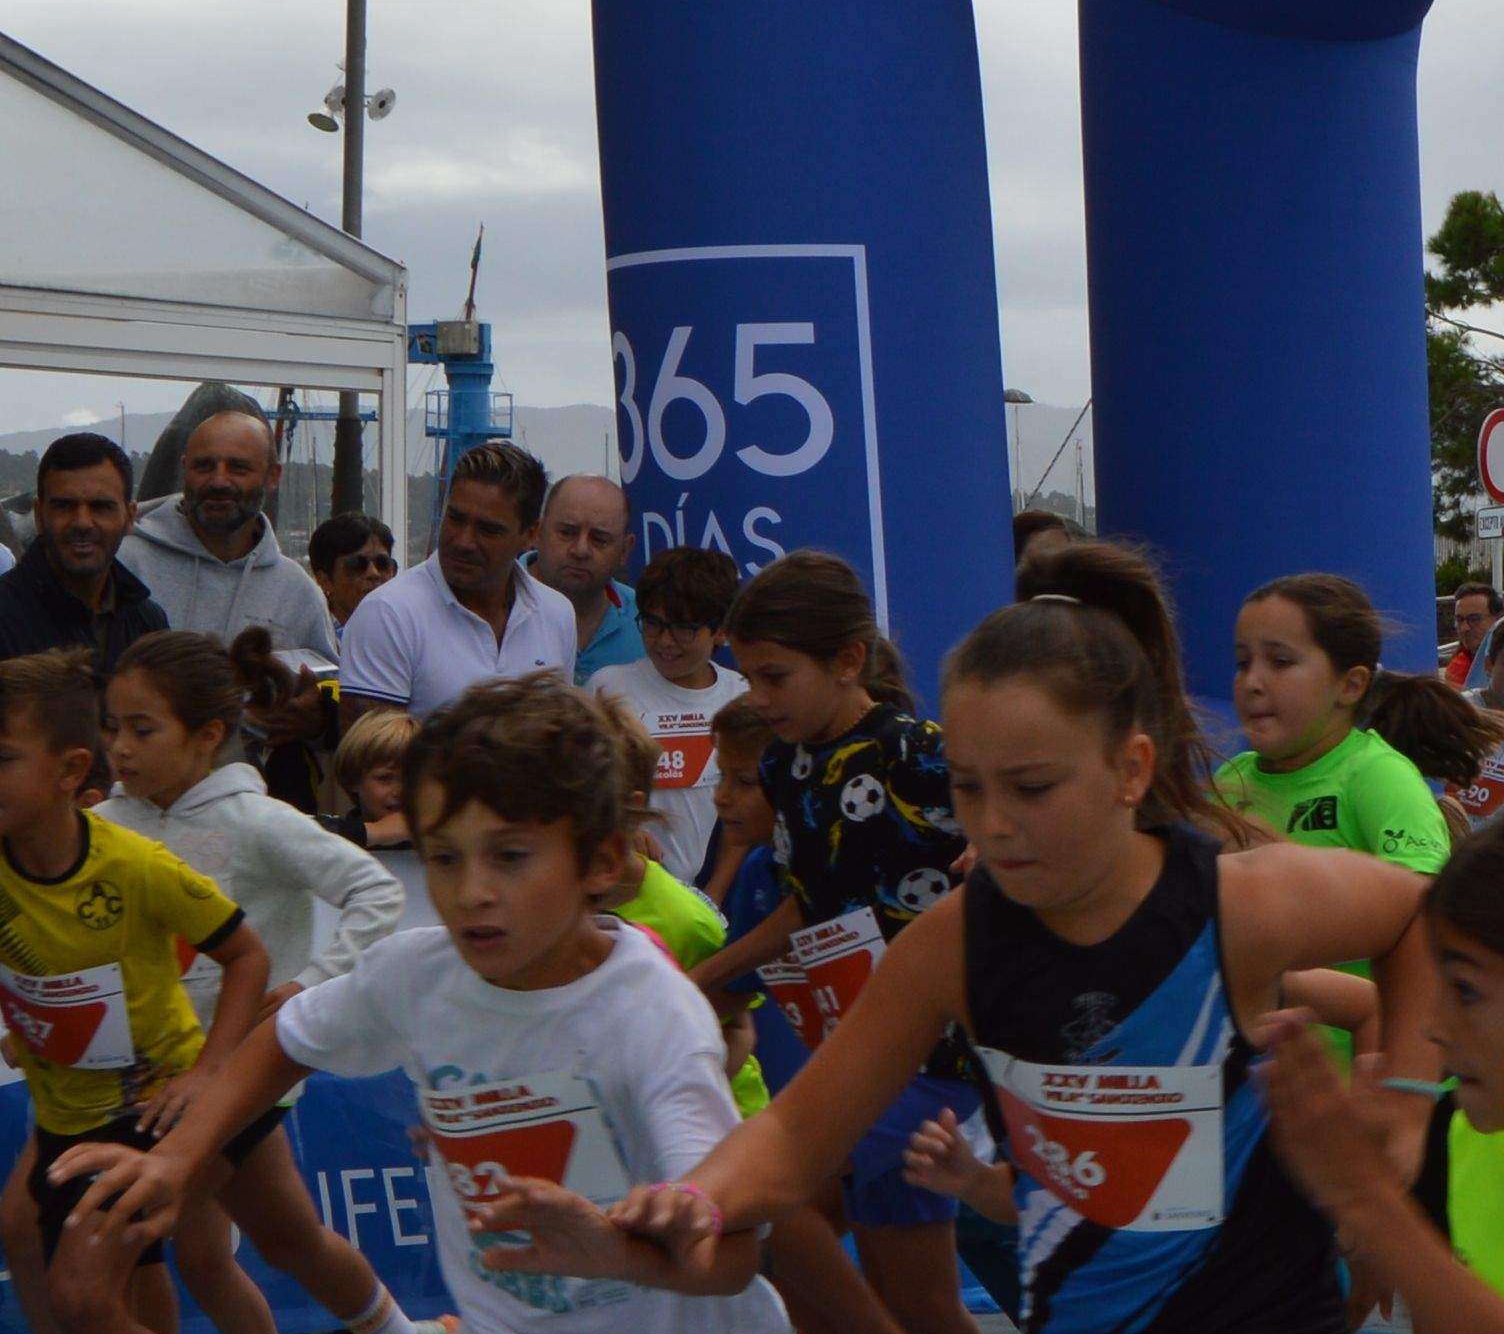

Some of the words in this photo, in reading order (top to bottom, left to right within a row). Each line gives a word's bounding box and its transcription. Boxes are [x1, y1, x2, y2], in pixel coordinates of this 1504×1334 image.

[611, 322, 834, 484] 365
[657, 750, 685, 769] 48
[1097, 1074, 1162, 1090] MILLA
